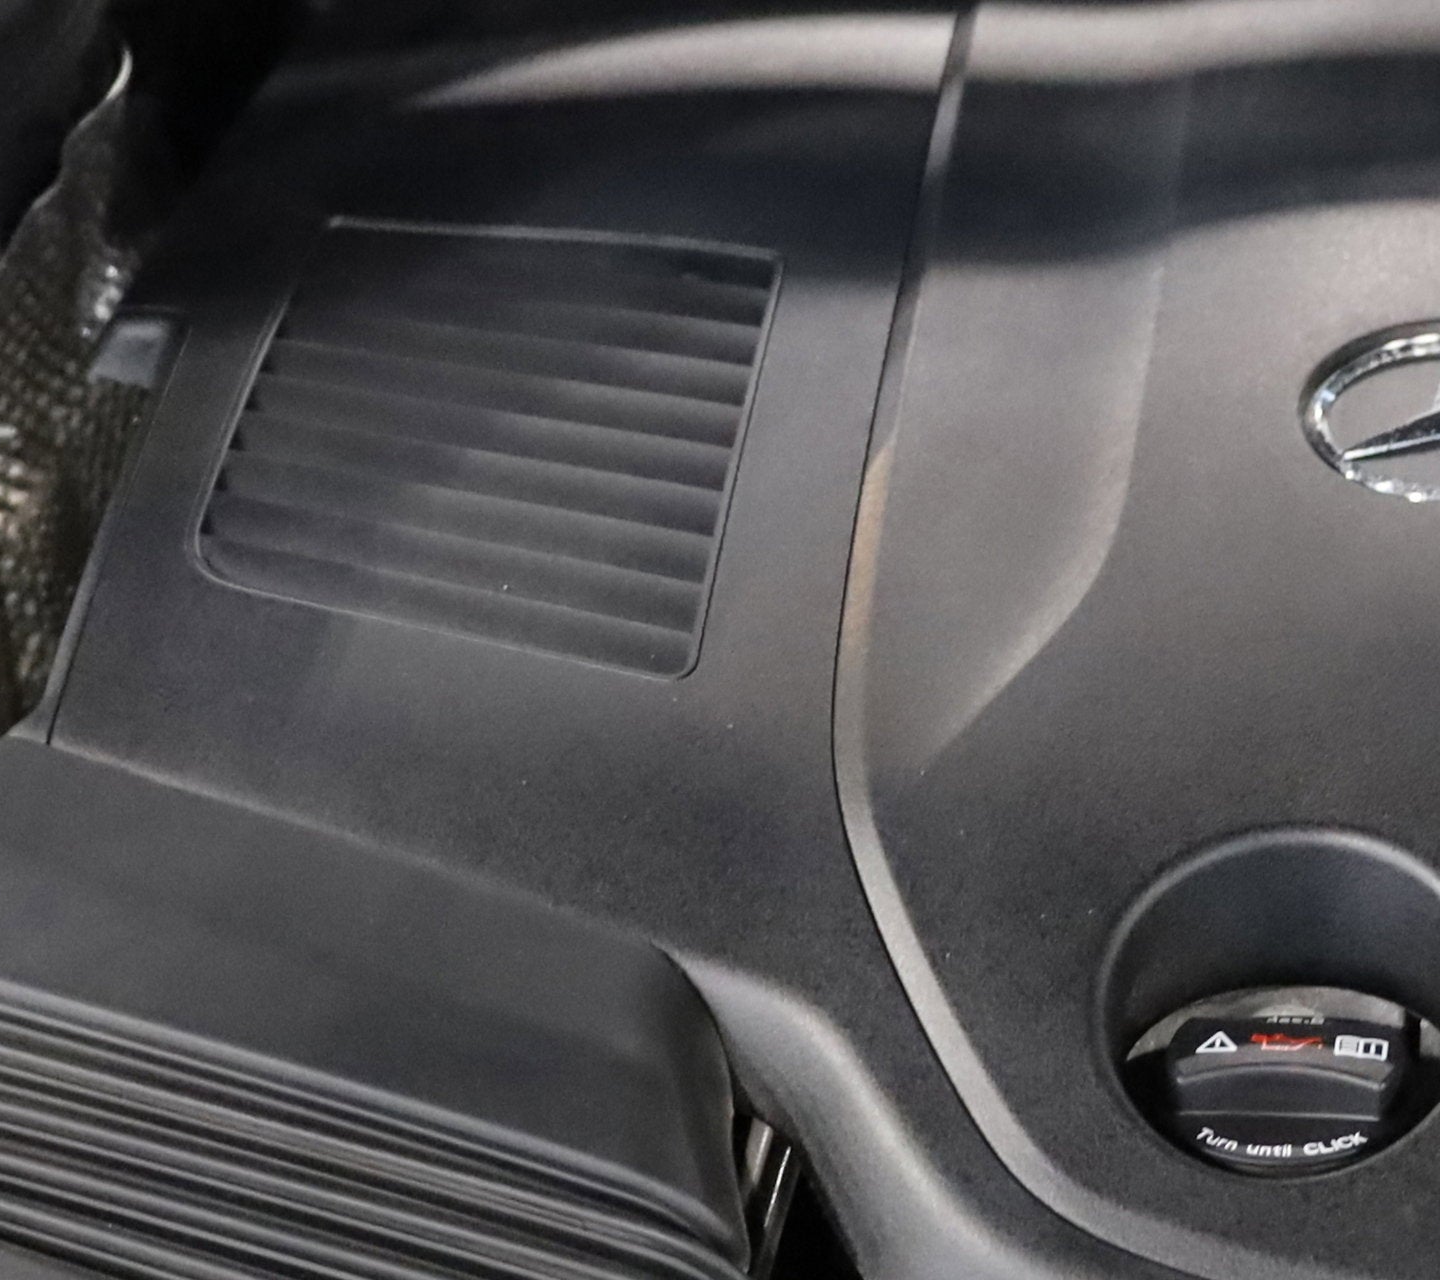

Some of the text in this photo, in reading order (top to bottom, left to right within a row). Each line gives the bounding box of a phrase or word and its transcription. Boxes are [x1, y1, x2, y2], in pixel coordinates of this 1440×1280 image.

[1195, 1127, 1368, 1158] Turn until CLICK
